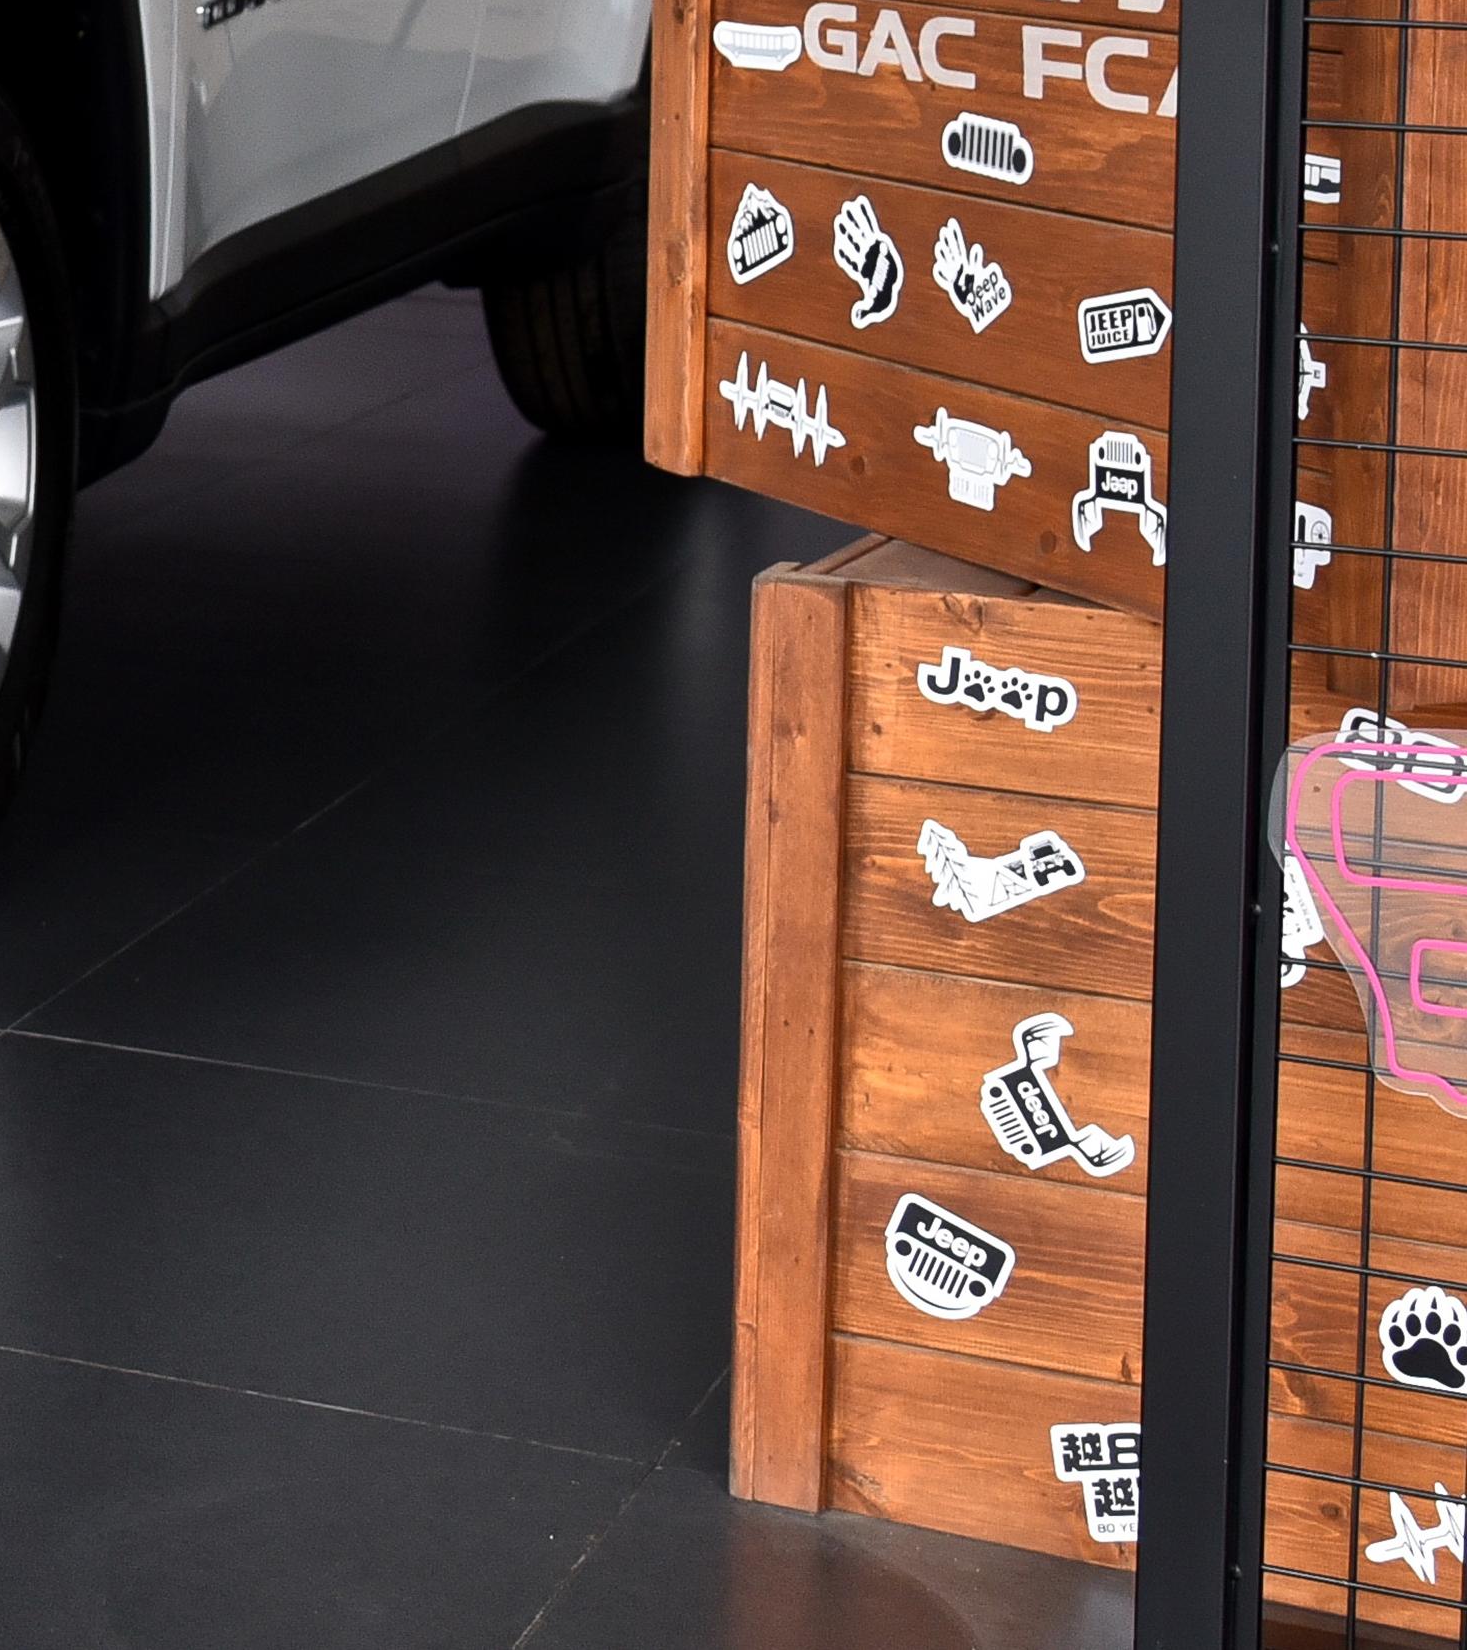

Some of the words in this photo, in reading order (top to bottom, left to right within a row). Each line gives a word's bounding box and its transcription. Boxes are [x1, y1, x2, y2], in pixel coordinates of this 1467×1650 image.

[803, 1, 977, 91] GAC
[967, 270, 999, 307] Jeep
[971, 286, 1007, 323] Wave
[1089, 308, 1133, 333] JEEP
[1090, 328, 1131, 347] JUICE
[1017, 1080, 1059, 1139] deer
[916, 1216, 988, 1268] Jeep
[1091, 1477, 1140, 1518] 越
